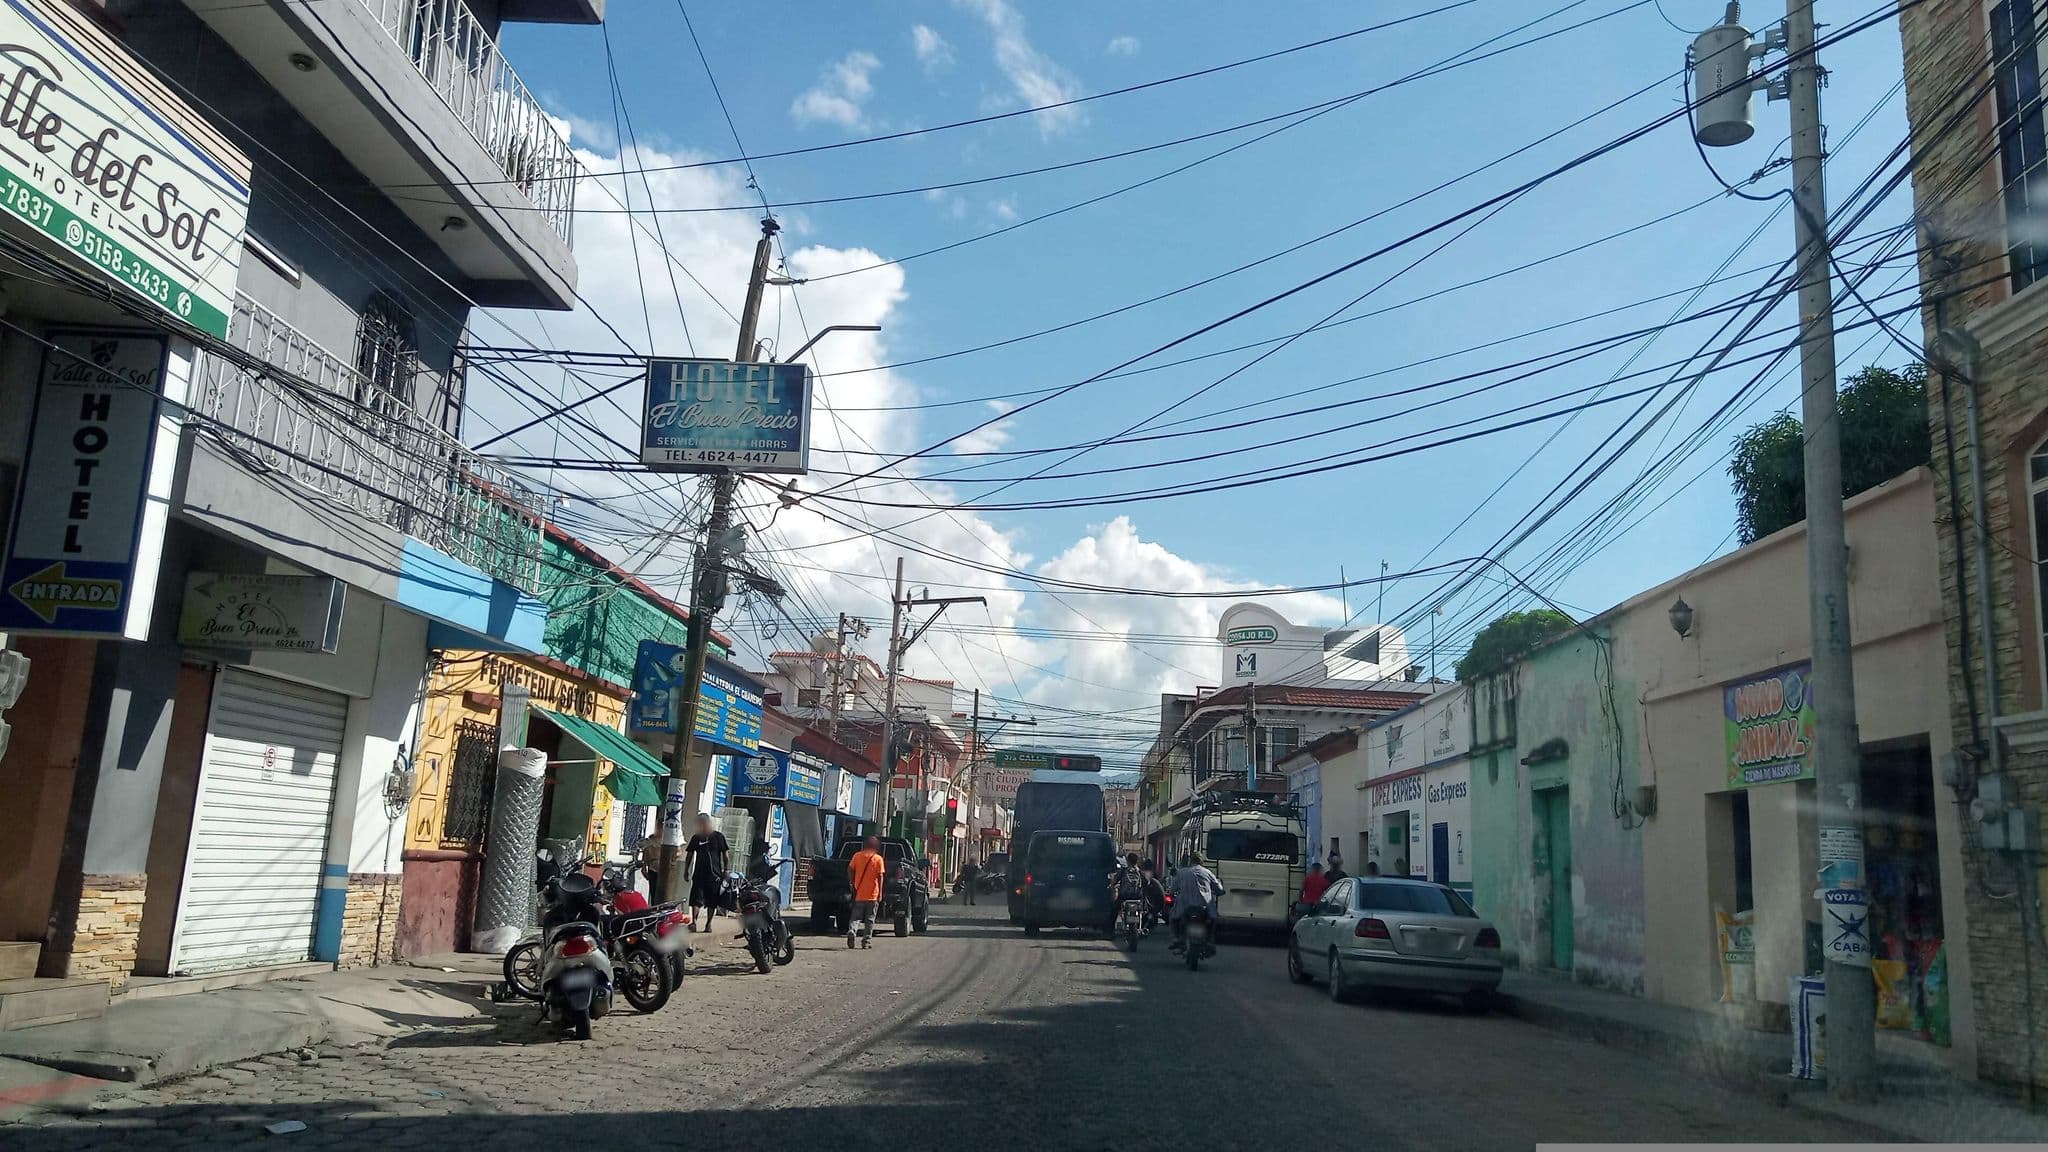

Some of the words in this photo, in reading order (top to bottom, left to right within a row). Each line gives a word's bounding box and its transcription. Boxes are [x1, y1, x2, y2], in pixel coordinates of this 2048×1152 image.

[33, 162, 115, 230] HOTEL
[71, 128, 152, 211] del
[143, 183, 221, 261] Sol
[85, 235, 170, 302] 5158-3433
[128, 367, 158, 386] Sol
[670, 363, 780, 404] HOTEL
[650, 401, 679, 430] El
[678, 403, 733, 430] Buen
[736, 406, 799, 431] Precio
[664, 450, 693, 461] TEL:
[697, 451, 779, 464] 4624-4477
[751, 440, 788, 449] HORAS
[64, 394, 112, 553] HOTEL
[21, 582, 118, 602] ENTRADA
[480, 657, 557, 705] FERRETERIA
[1735, 671, 1802, 723] MUNDO
[1739, 717, 1806, 765] ANIMAL
[1392, 776, 1422, 803] EXPRESS
[1428, 785, 1440, 802] Gas
[1440, 782, 1467, 804] Express
[1826, 893, 1855, 902] VOTA
[1833, 942, 1869, 953] CABA
